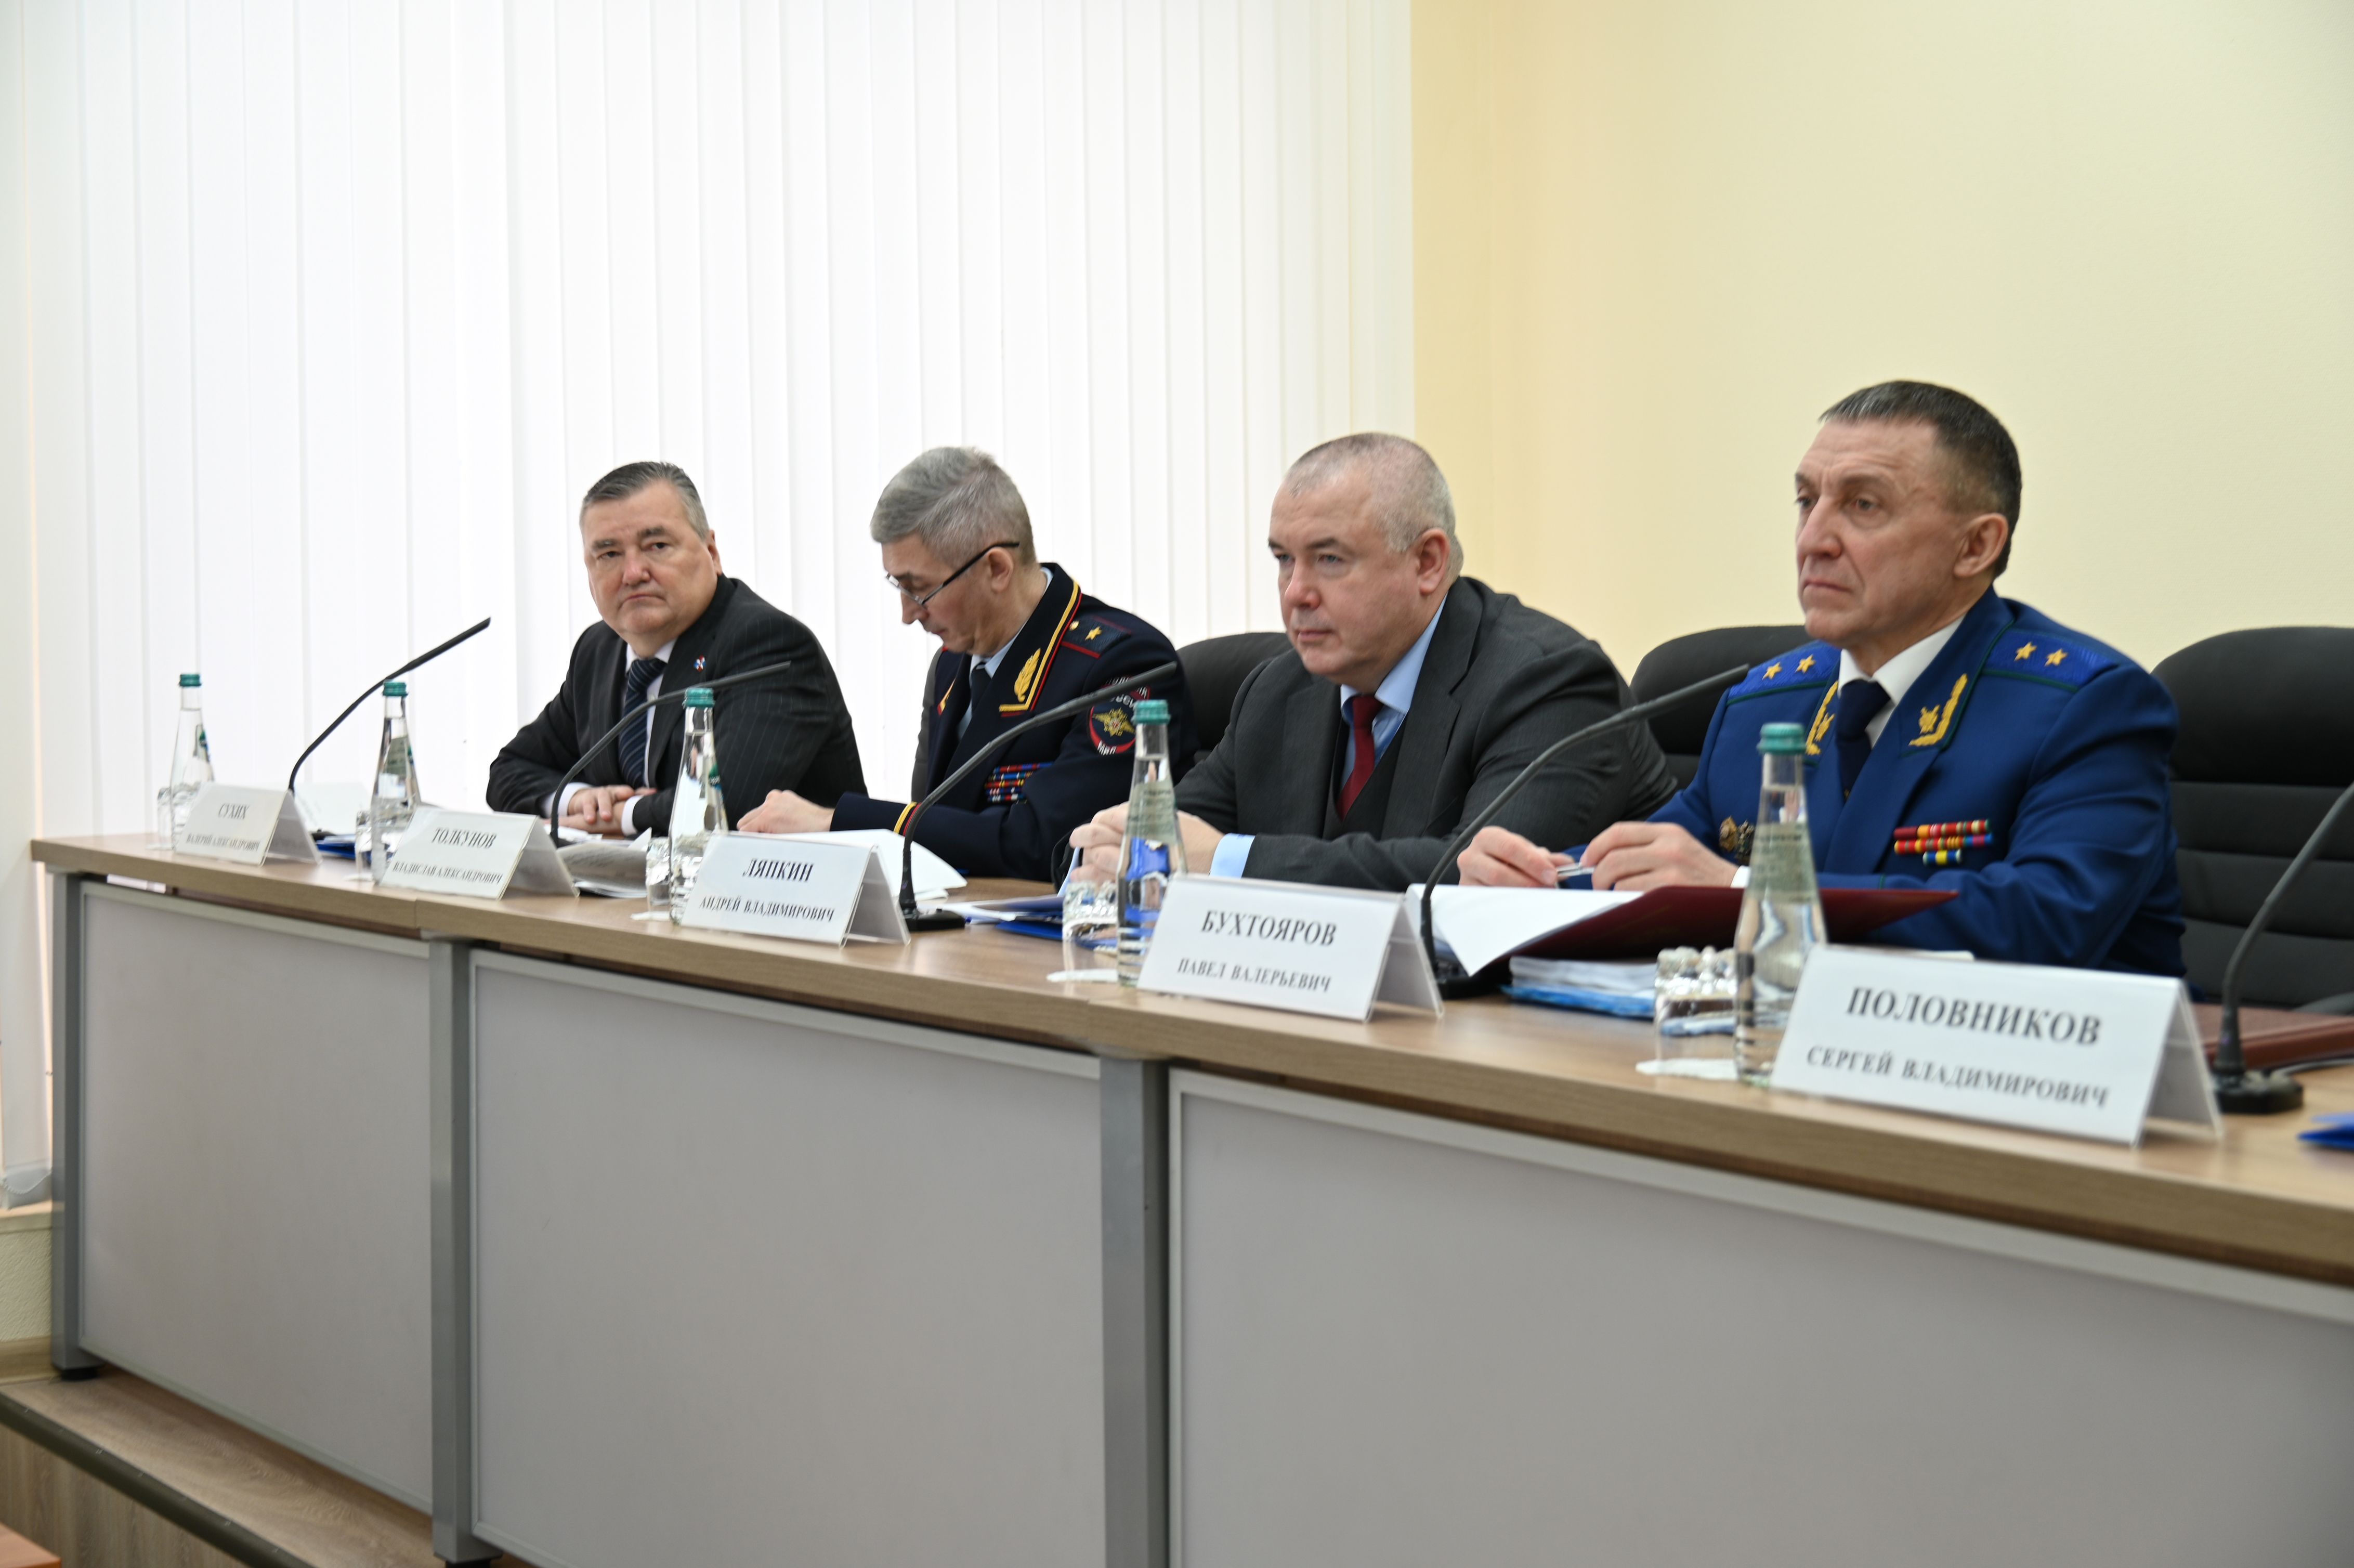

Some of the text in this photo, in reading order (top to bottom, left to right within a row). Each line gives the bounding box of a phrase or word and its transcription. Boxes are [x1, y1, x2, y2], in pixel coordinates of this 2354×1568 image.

[218, 803, 250, 820] СУХИХ
[186, 833, 213, 846] ВАЛЕРИЙ
[431, 827, 497, 848] ТОЛКУНОВ
[393, 861, 503, 884] ВЛАДИСЛАВ АЛЕКСАНДРОВИЧ
[742, 858, 814, 882] ЛЯПКИН
[700, 895, 835, 921] АНДРЕЙ ВЛАДИМИРОВИЧ
[1201, 910, 1337, 946] БУХТОЯРОВ
[1177, 958, 1331, 992] ПАВЕЛ ВАЛЕРЬЕВИЧ
[1846, 987, 2102, 1045] ПОЛОВНИКОВ
[1806, 1046, 2111, 1108] СЕРГЕЙ ВЛАДИМИРОВИЧ
